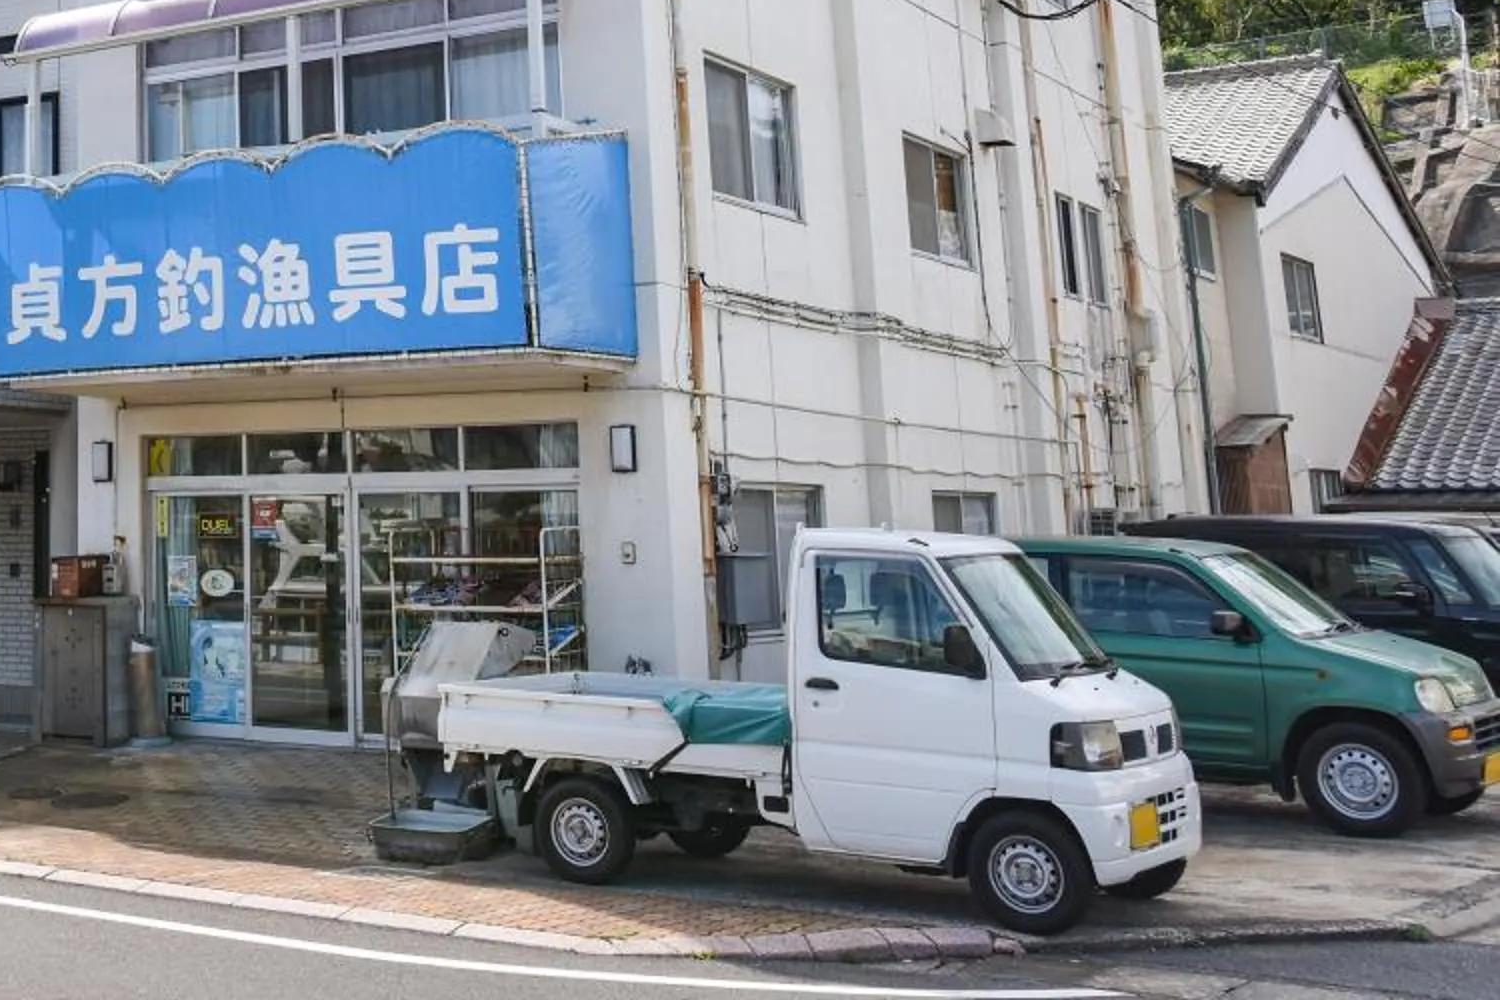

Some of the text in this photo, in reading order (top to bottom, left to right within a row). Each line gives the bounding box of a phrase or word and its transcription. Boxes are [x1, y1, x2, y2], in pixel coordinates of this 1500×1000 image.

[6, 223, 500, 345] 貞方釣漁具店
